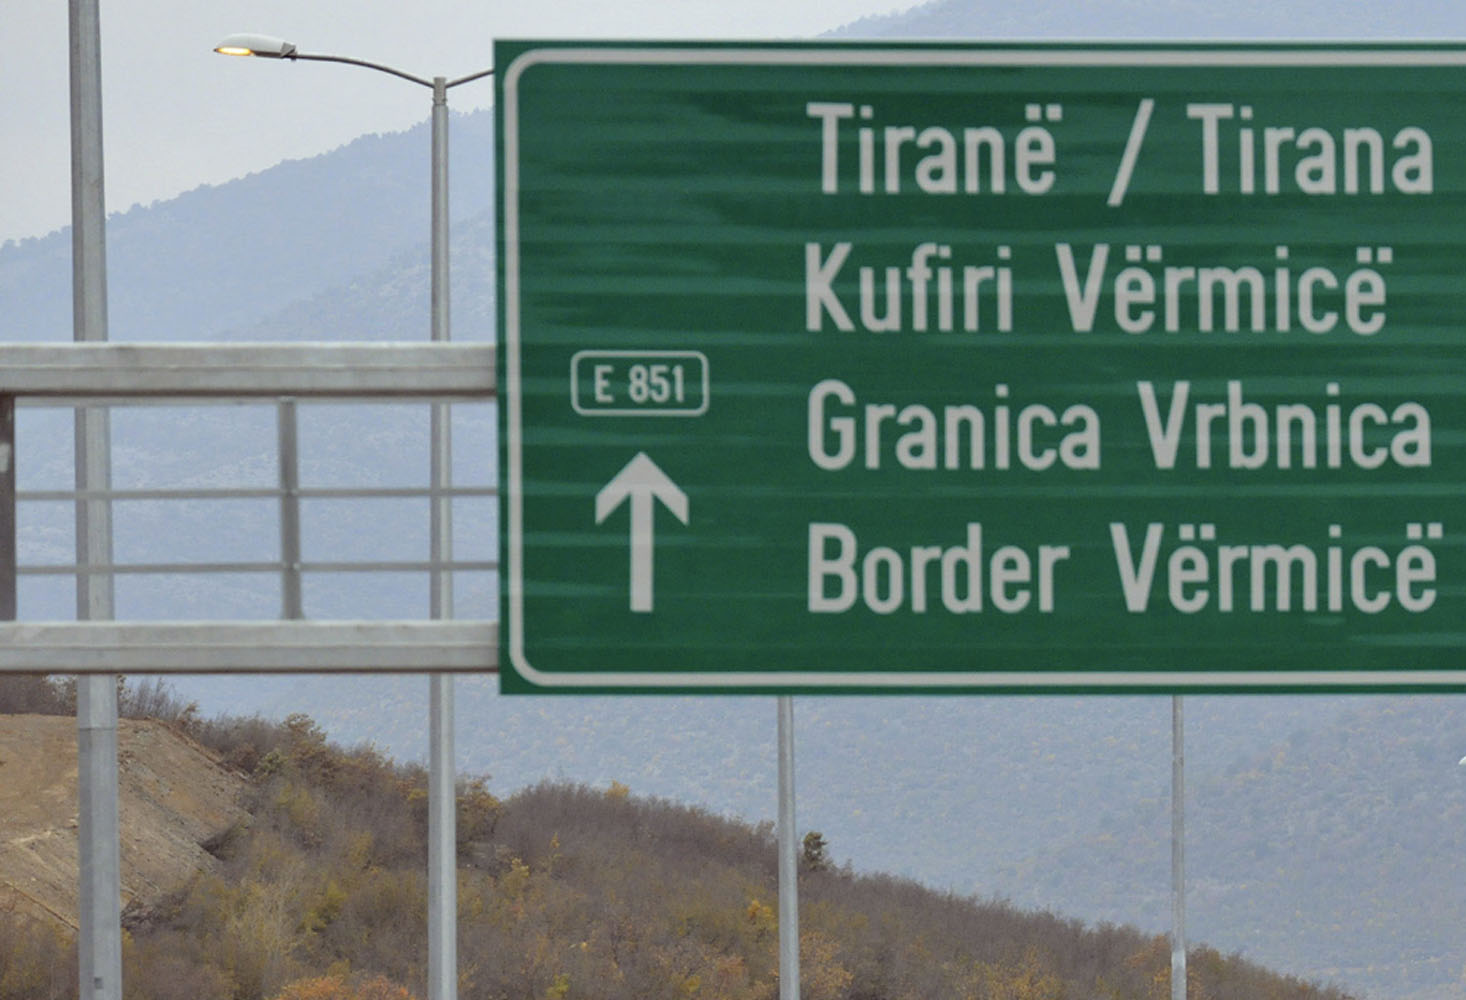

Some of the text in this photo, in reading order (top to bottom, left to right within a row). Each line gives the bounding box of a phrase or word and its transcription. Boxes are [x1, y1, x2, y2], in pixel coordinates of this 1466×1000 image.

[807, 99, 1433, 206] Tiranë / Tirana
[805, 242, 1393, 334] Kufiri Vërmicë
[594, 365, 684, 403] E 851
[808, 379, 1432, 470] Granica Vrbnica
[808, 522, 1443, 614] Border Vërmicë
